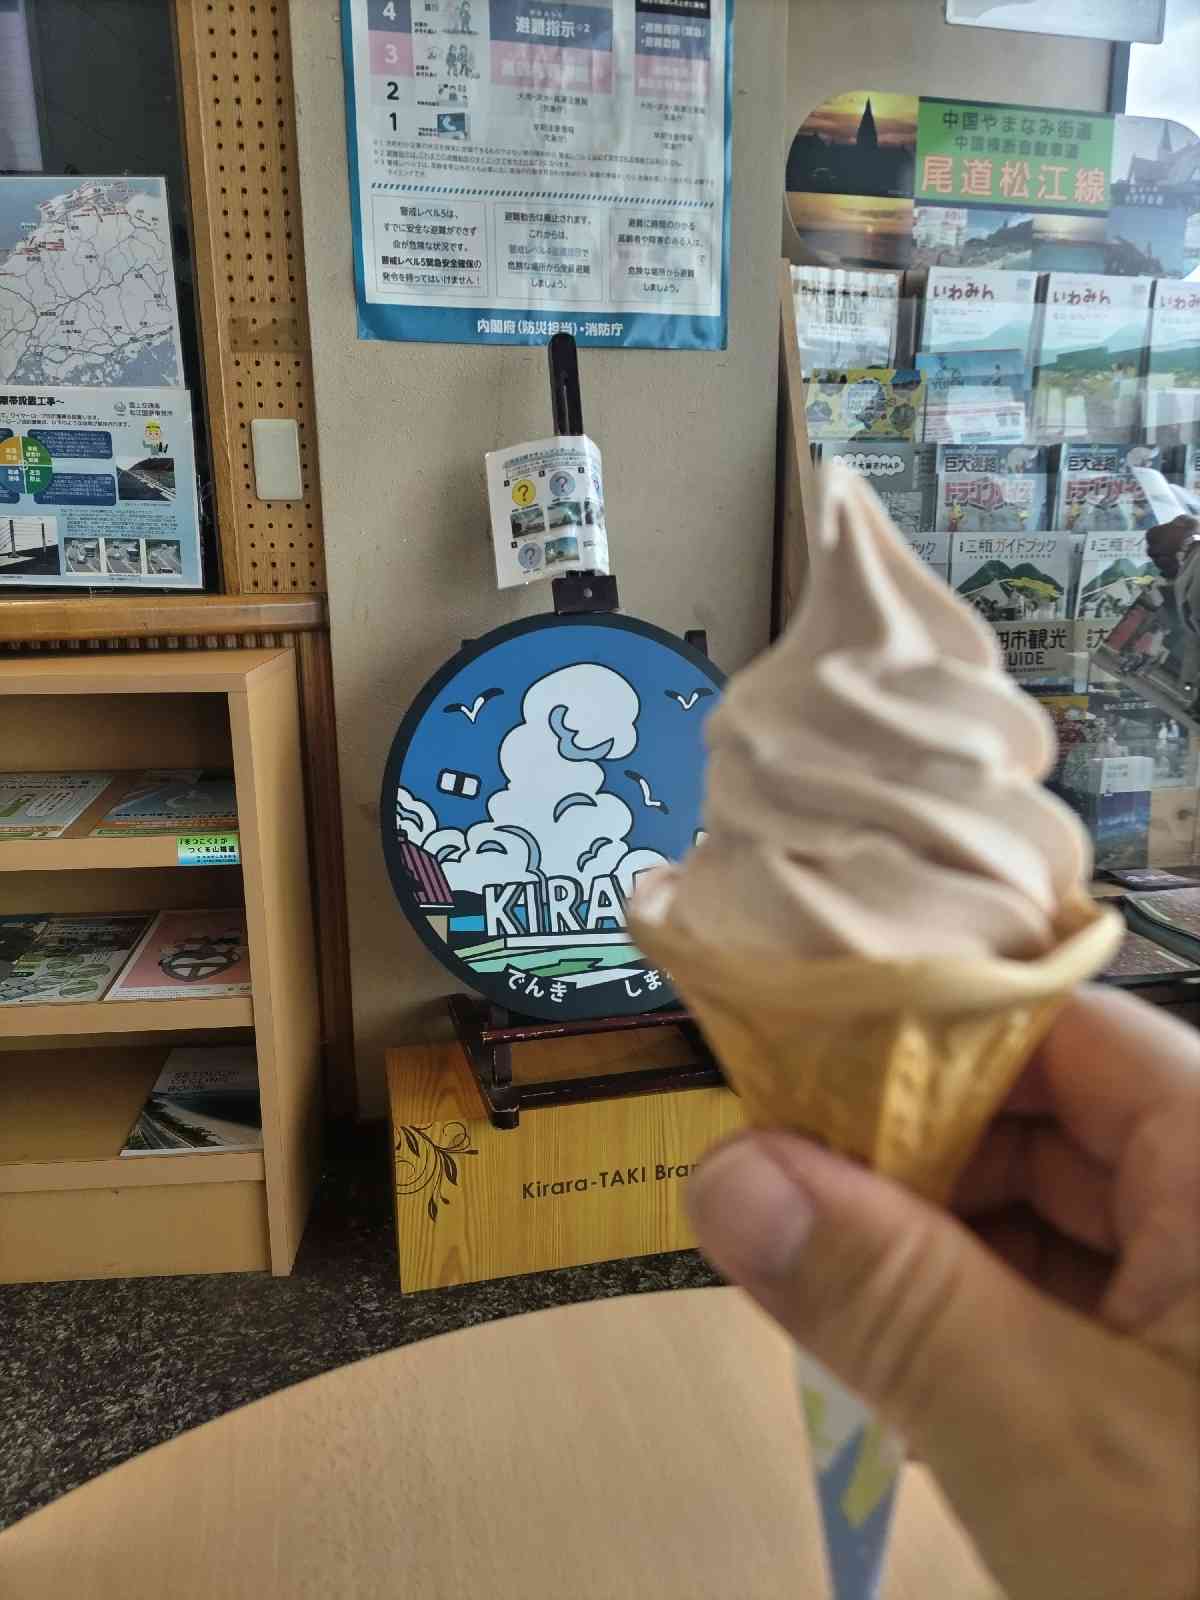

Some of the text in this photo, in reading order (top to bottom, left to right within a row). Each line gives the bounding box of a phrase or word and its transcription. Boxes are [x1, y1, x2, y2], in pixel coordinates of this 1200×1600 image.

[382, 0, 396, 20] 4
[385, 43, 397, 64] 3
[386, 81, 399, 101] 2
[389, 112, 397, 131] 1
[943, 110, 1092, 140] 中国やまなみ街道
[921, 155, 1105, 204] 尾道松江線
[934, 283, 994, 300] いわみん
[1053, 288, 1111, 304] いわみん
[483, 874, 644, 937] KIRA
[507, 968, 568, 1003] でんき
[521, 1166, 647, 1200] Kirara-TAKI
